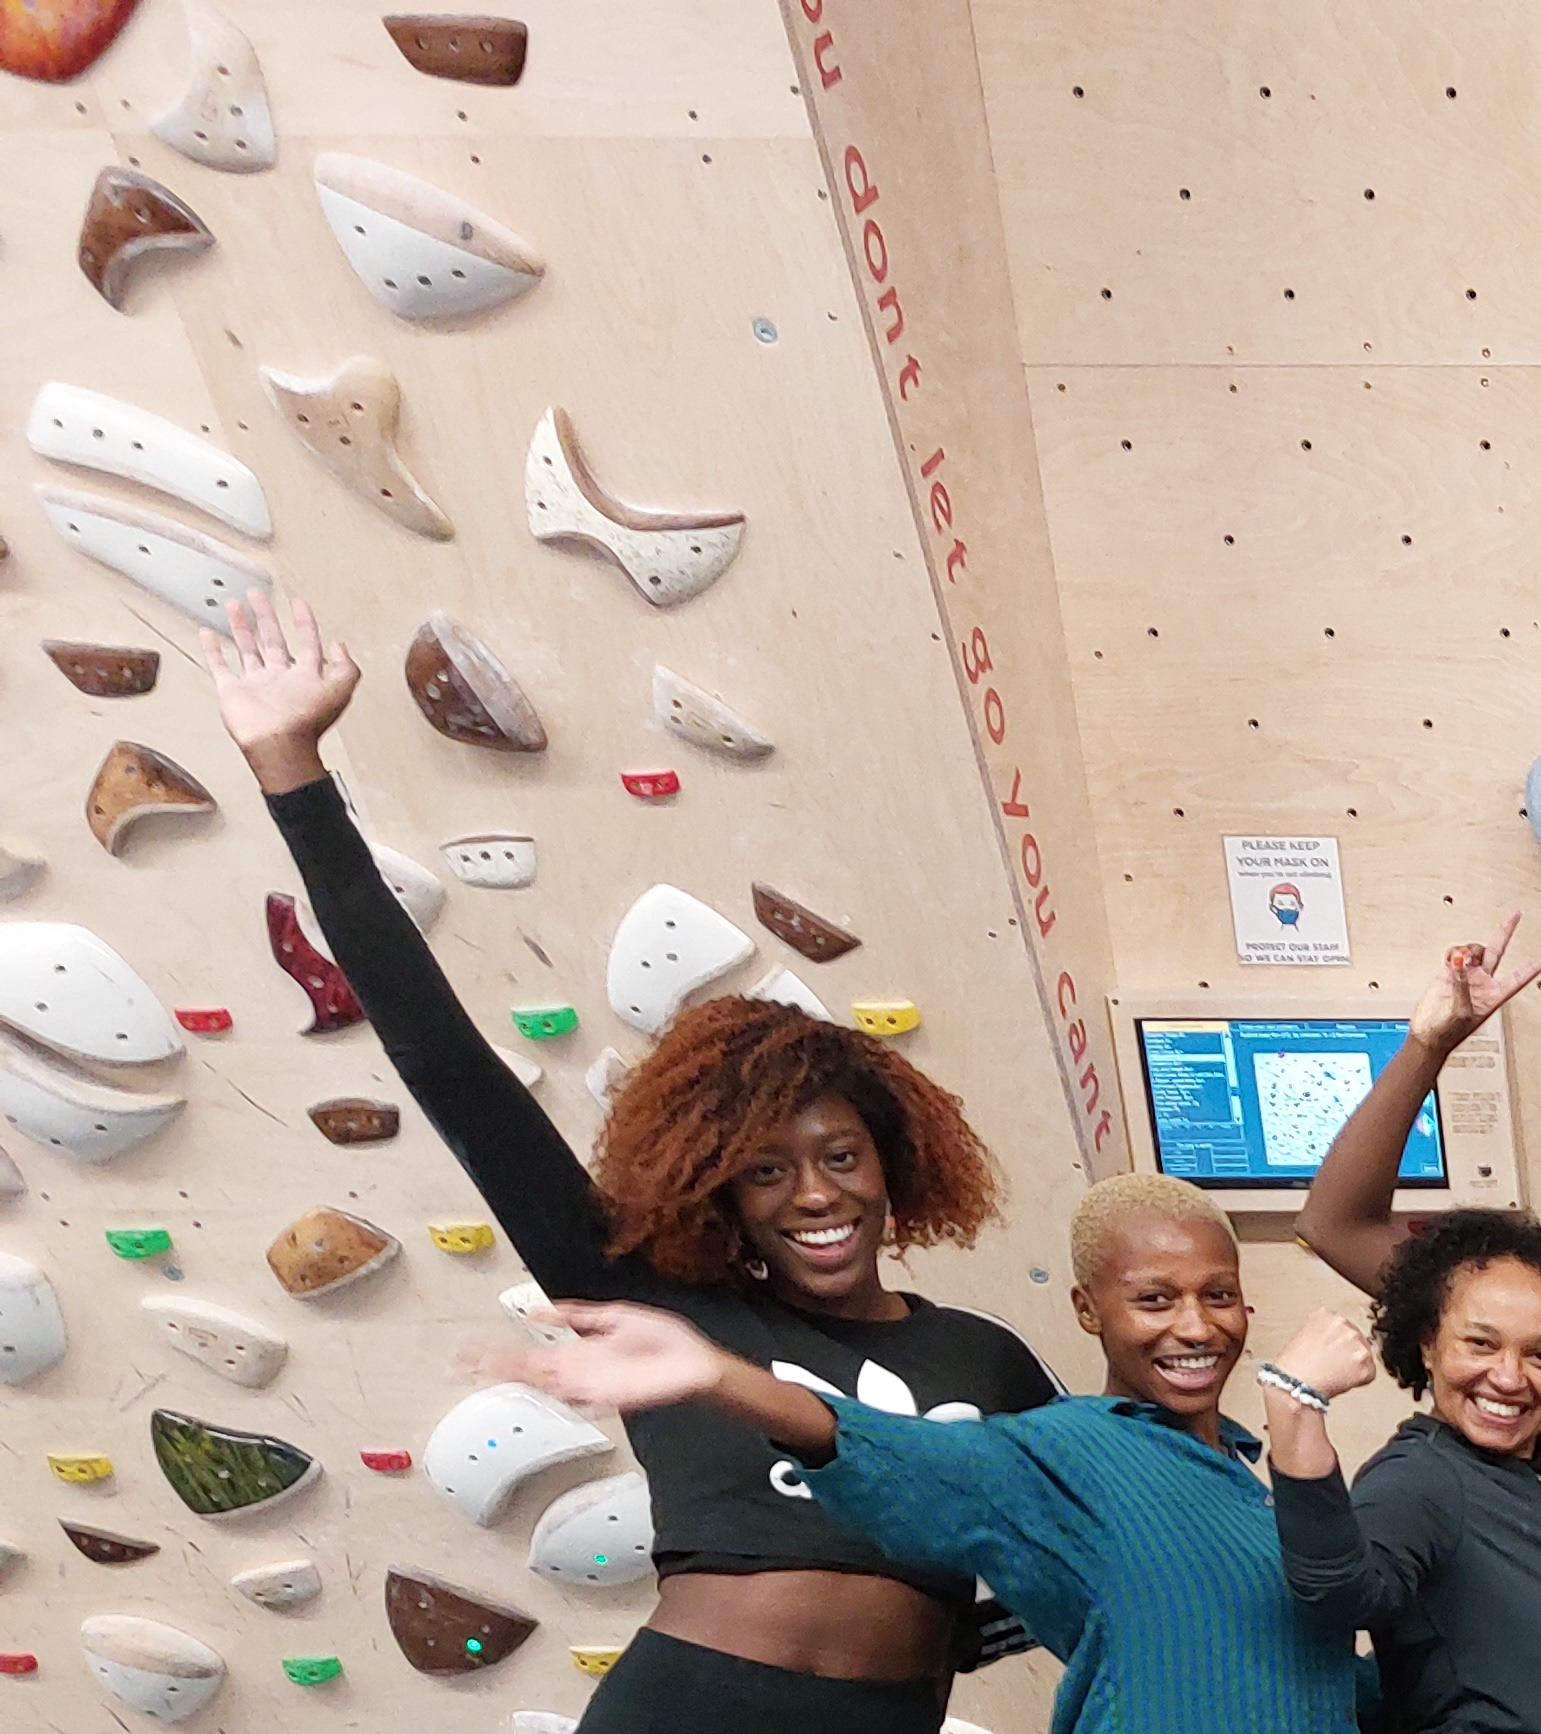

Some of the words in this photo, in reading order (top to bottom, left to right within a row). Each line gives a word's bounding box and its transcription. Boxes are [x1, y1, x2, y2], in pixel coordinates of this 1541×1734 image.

[845, 144, 923, 402] dont
[921, 447, 968, 584] let
[962, 626, 1005, 746] go
[1057, 971, 1113, 1154] cant
[1241, 840, 1287, 851] PLEASE
[1236, 856, 1271, 867] YOUR
[1273, 857, 1308, 868] MASK
[1310, 857, 1329, 867] ON
[1288, 942, 1310, 952] OUR
